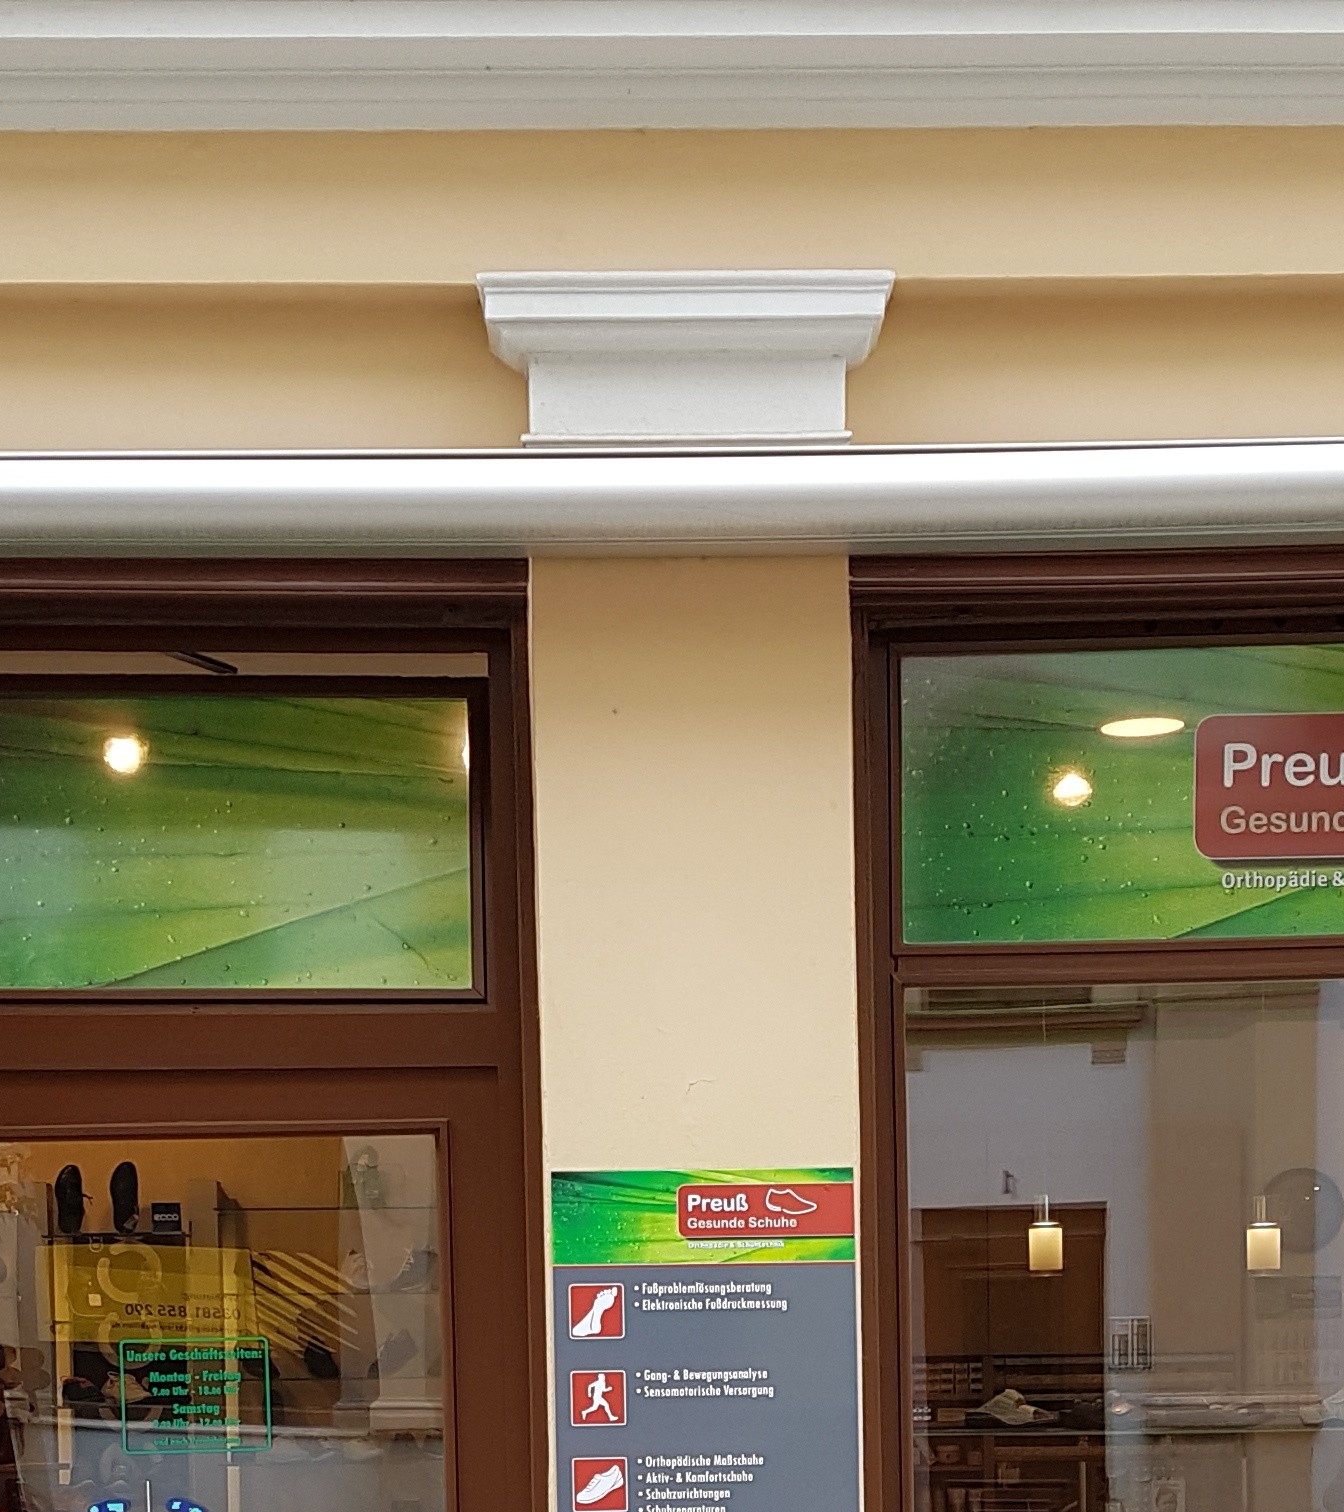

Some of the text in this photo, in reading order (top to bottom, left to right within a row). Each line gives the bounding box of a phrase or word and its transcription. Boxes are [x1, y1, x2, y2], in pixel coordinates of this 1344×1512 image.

[1221, 869, 1328, 892] Orthopädie
[687, 1194, 749, 1213] Preuß
[687, 1216, 798, 1230] Gesunde Schuhe
[642, 1298, 788, 1312] Elektronische Fußdruckmessung
[126, 1350, 167, 1362] Unsere
[149, 1371, 192, 1384] Montag
[644, 1368, 768, 1383] Gang- & Bewegungsanalyse
[644, 1385, 774, 1399] Sensomotorische Versorgung
[172, 1403, 221, 1416] Samstag
[645, 1454, 764, 1469] Orthopädische Maßschuhe
[646, 1470, 754, 1484] Aktiv- & Komfortschuhe
